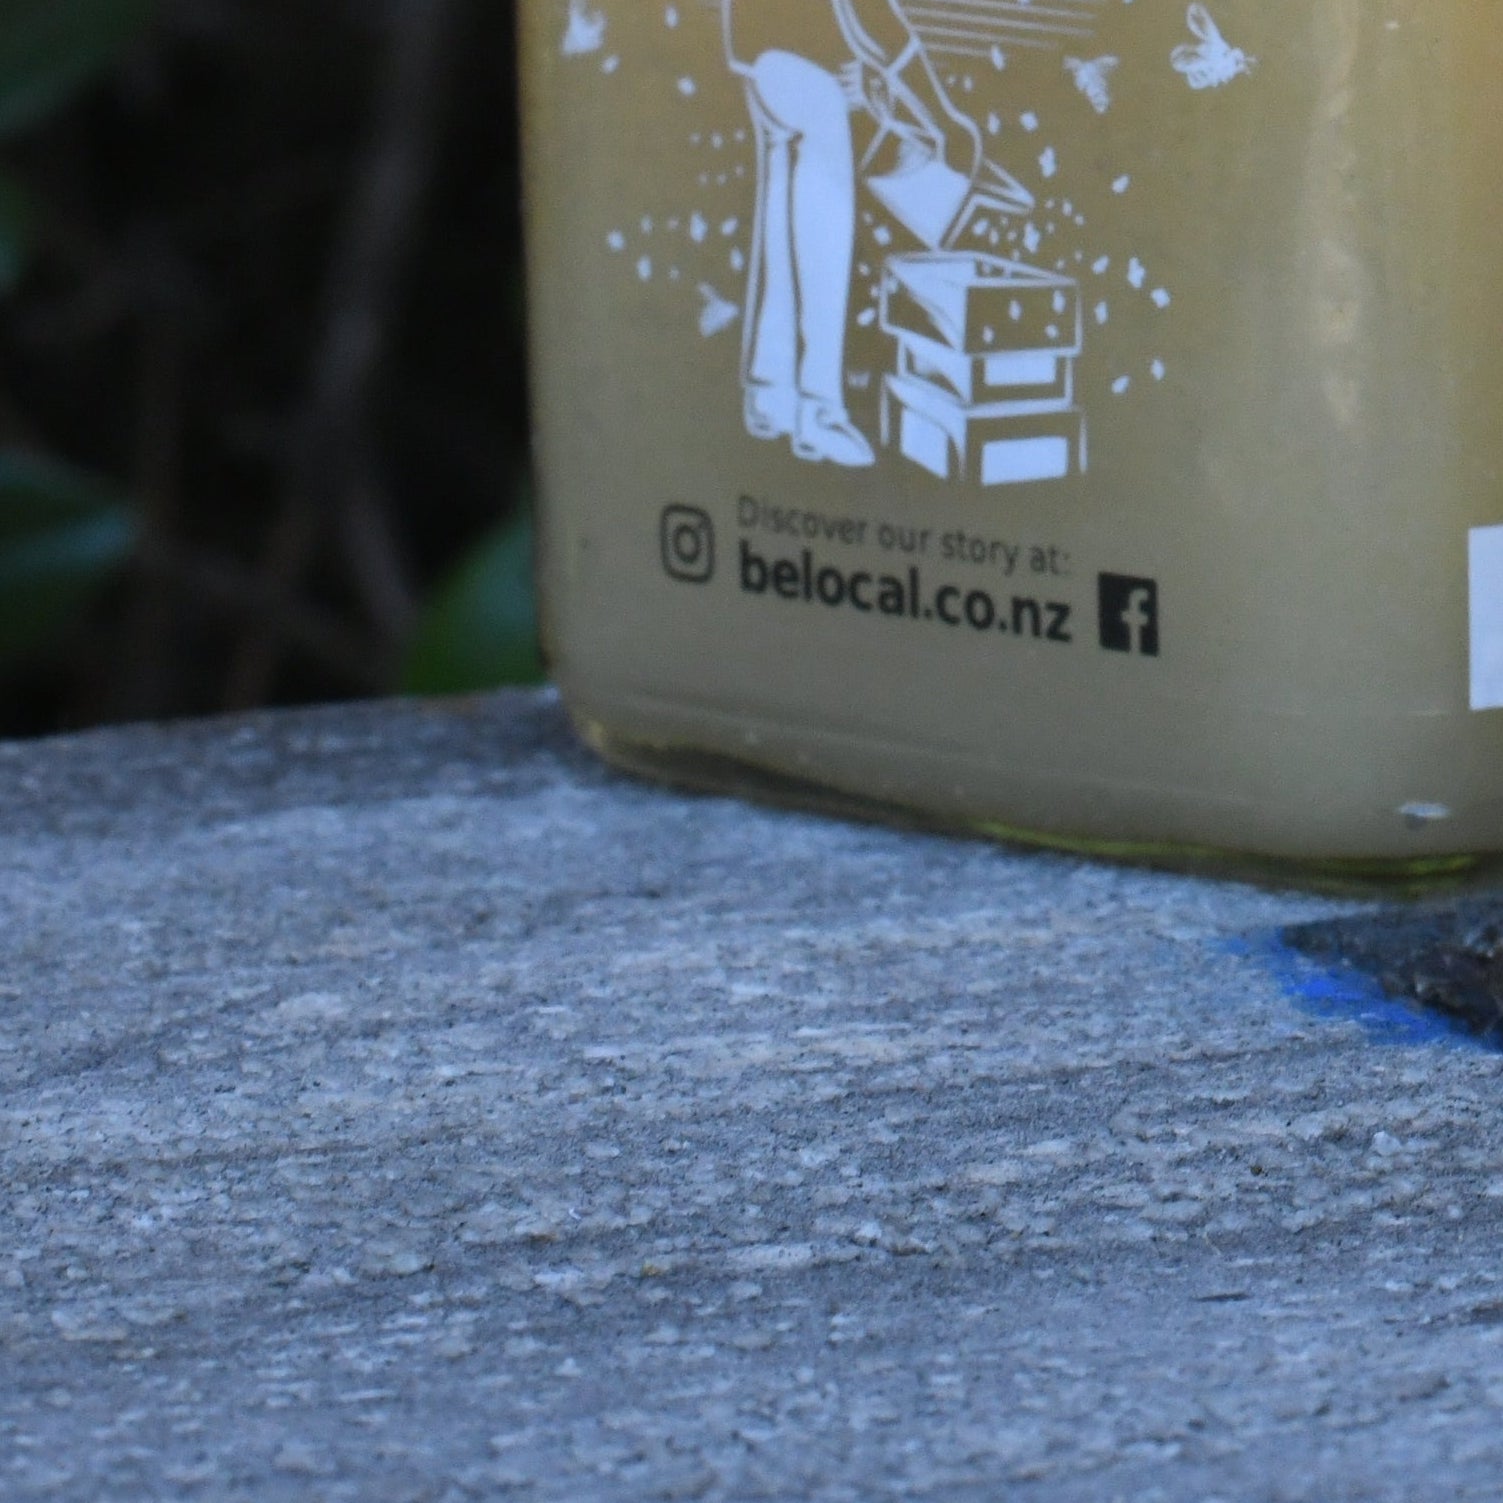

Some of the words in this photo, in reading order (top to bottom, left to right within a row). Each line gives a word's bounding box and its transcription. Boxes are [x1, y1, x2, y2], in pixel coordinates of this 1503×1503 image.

[736, 495, 868, 546] Discover
[878, 525, 929, 555] our
[940, 529, 1020, 577] story
[1029, 543, 1073, 575] at:
[737, 537, 1074, 643] belocal.co.nz
